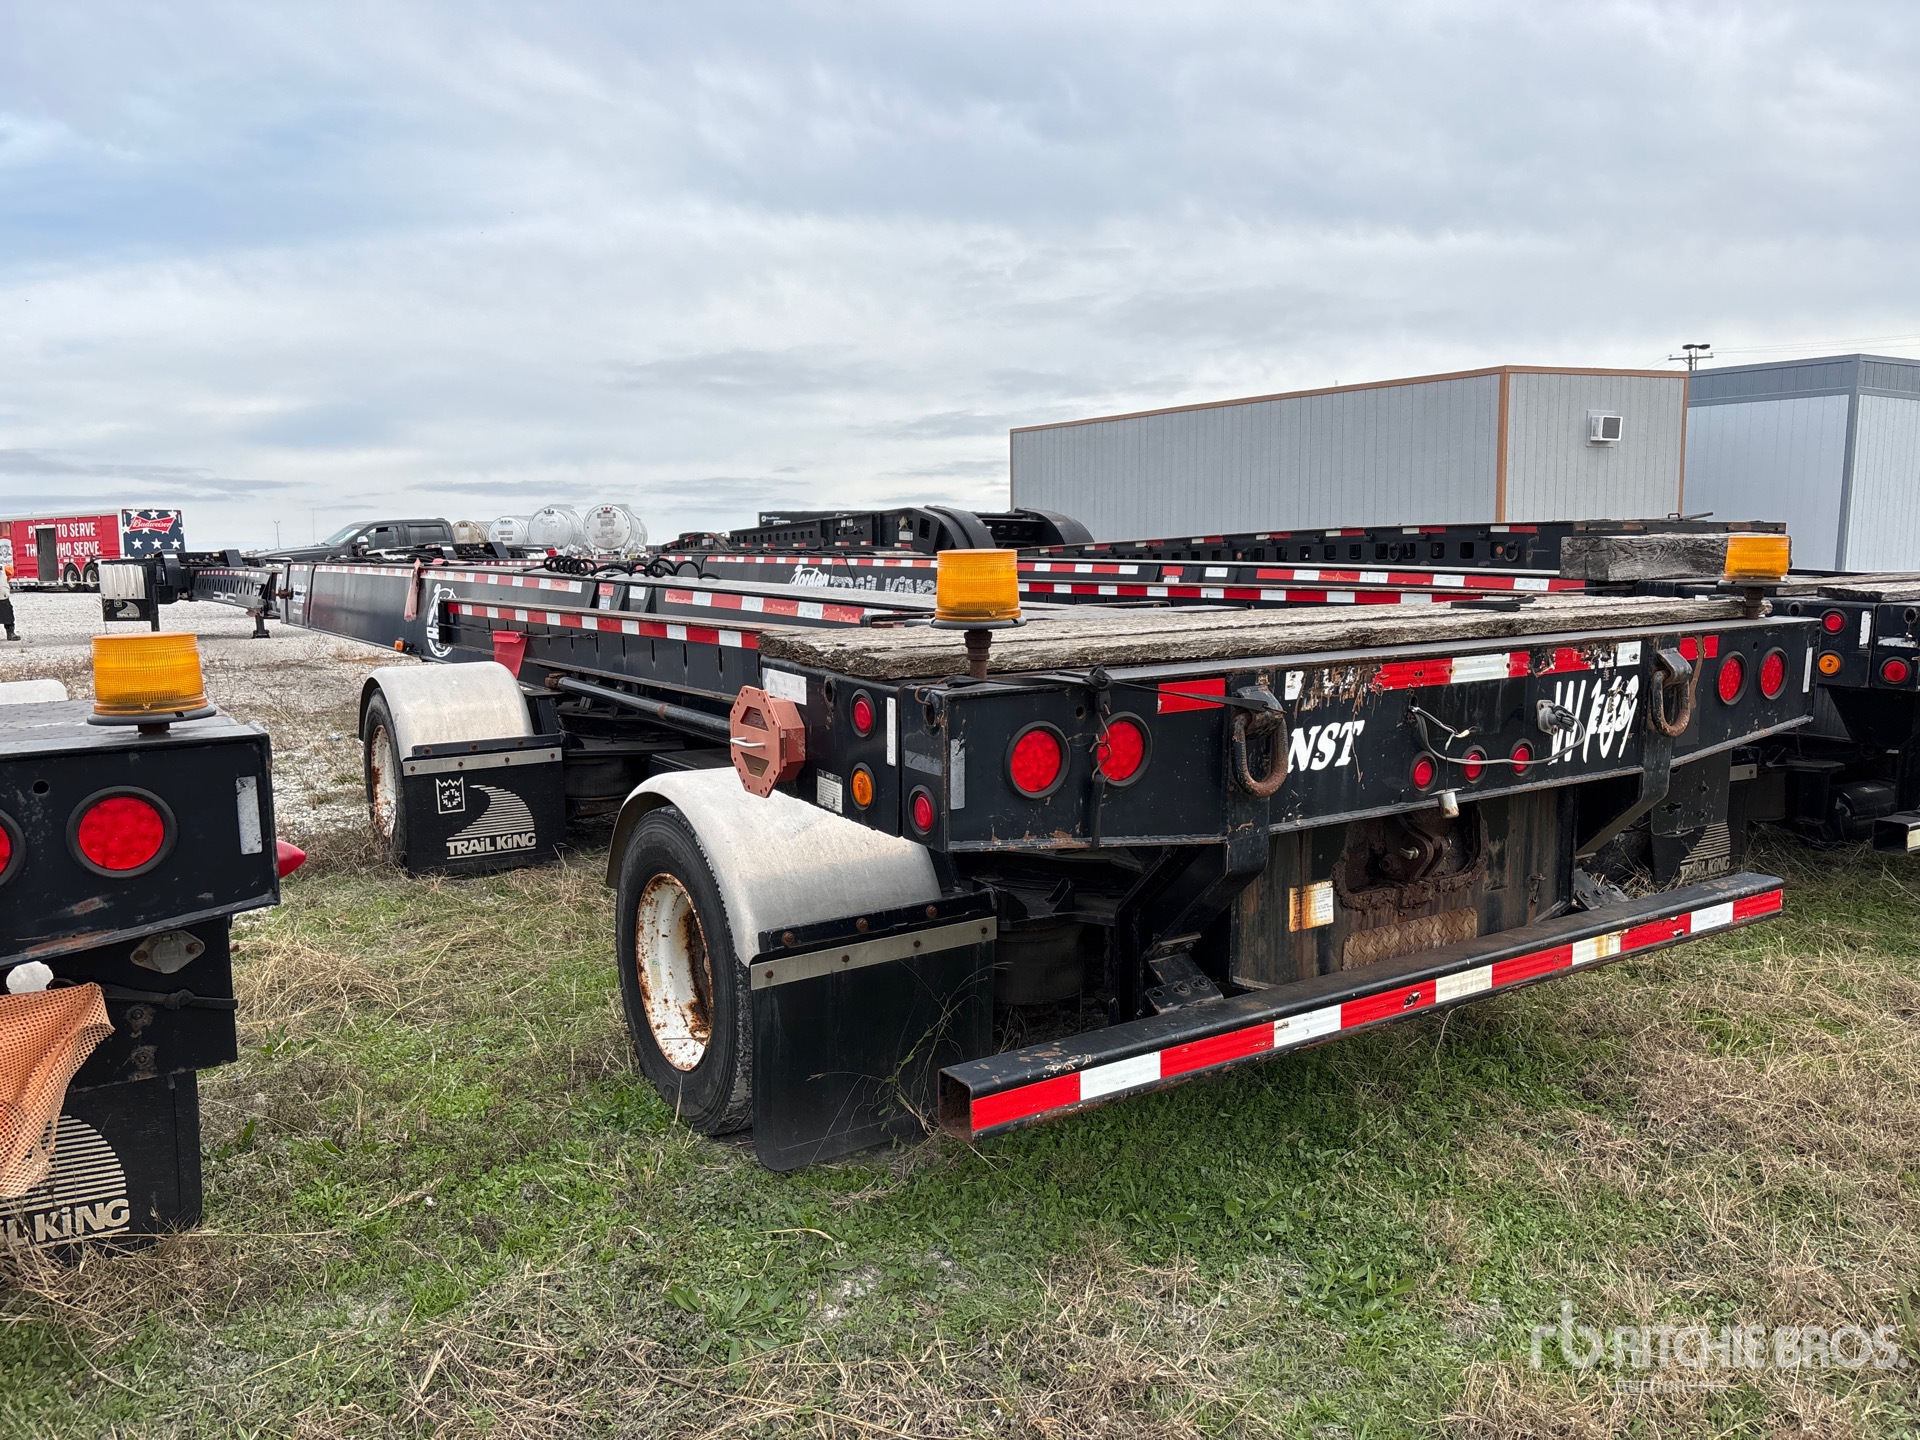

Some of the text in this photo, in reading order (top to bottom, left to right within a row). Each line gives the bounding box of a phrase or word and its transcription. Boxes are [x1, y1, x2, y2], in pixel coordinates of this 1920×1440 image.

[57, 523, 67, 537] TO
[70, 522, 96, 537] SERVE
[133, 519, 171, 528] Budweiser
